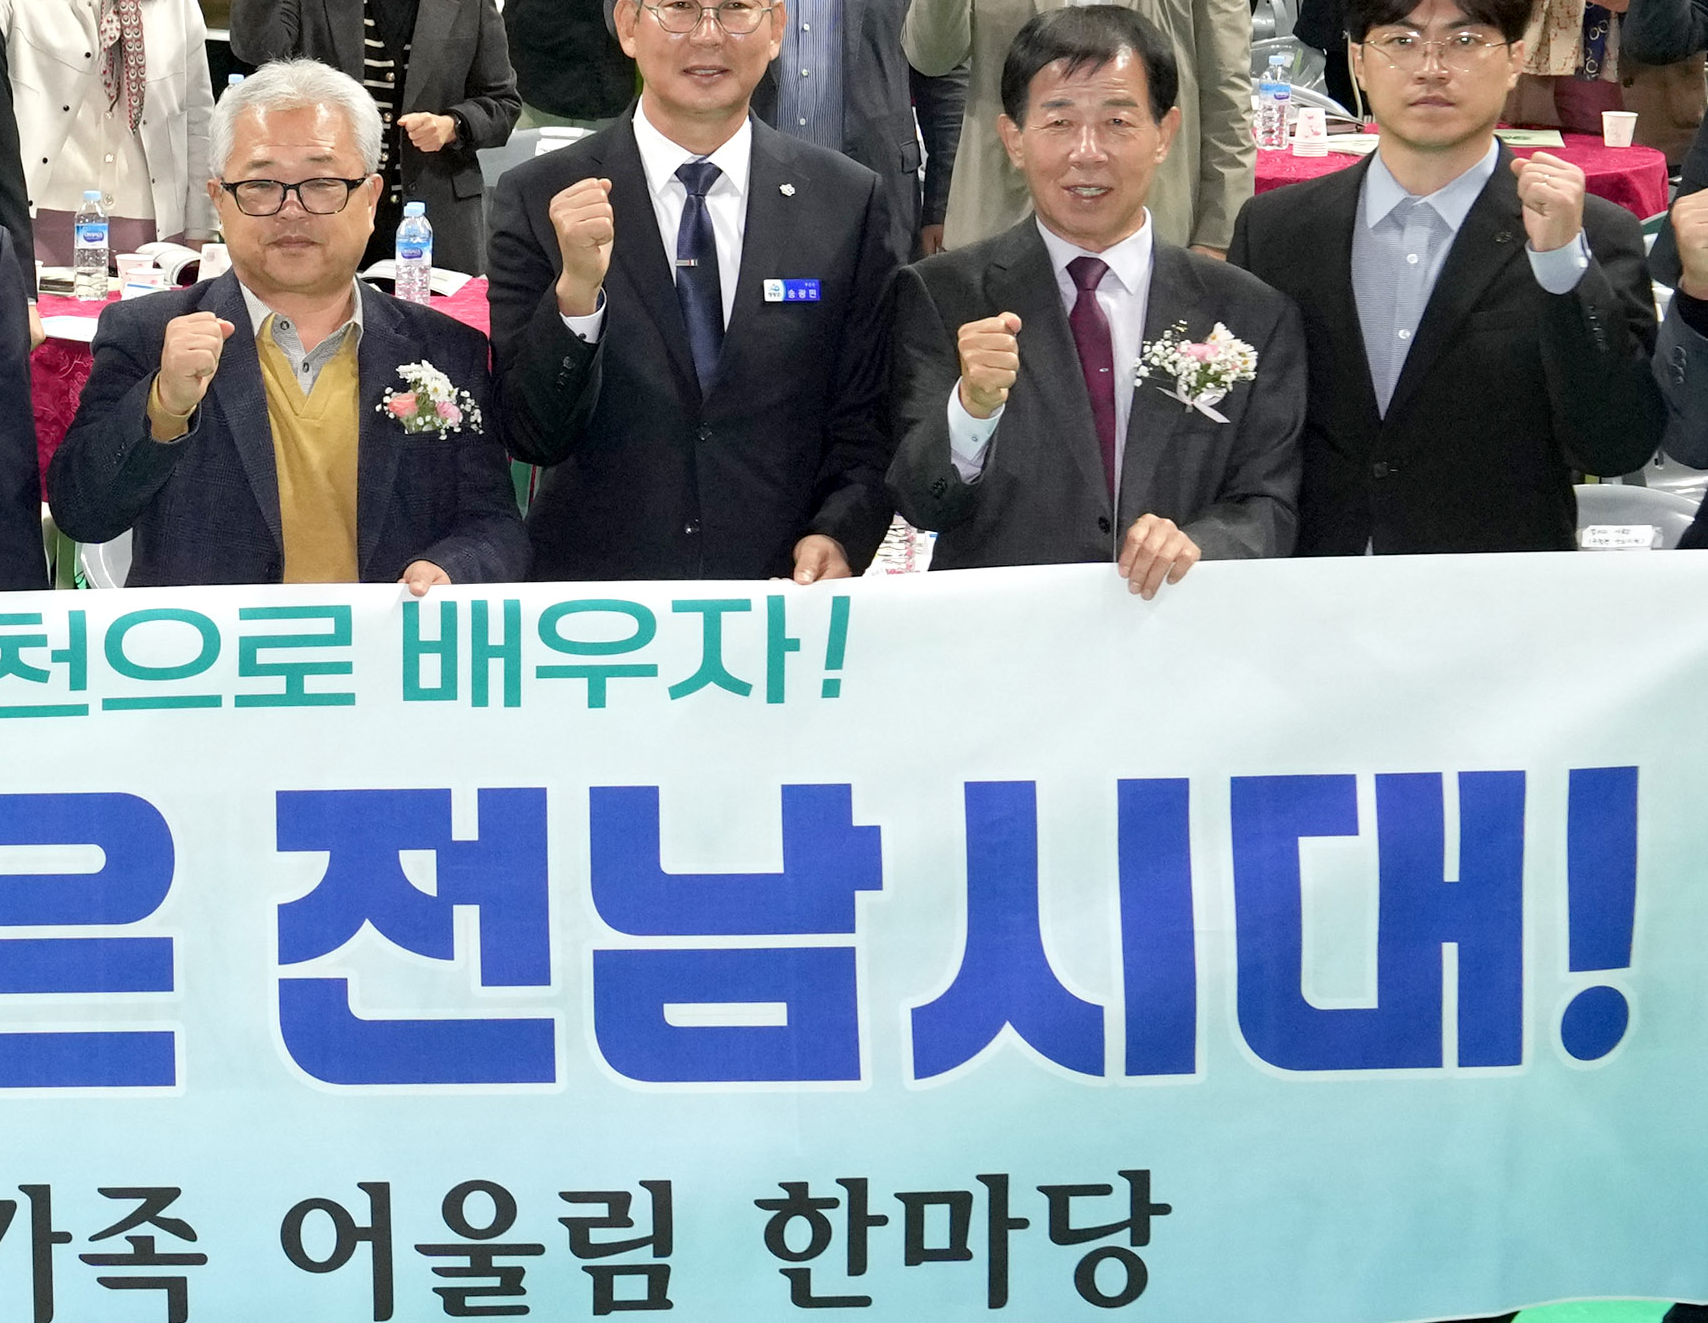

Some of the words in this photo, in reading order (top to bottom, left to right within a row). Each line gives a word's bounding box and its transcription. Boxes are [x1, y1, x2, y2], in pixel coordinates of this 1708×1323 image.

[401, 594, 852, 710] 배우자!
[279, 1178, 675, 1323] 어울림
[752, 1168, 1174, 1311] 한마당
